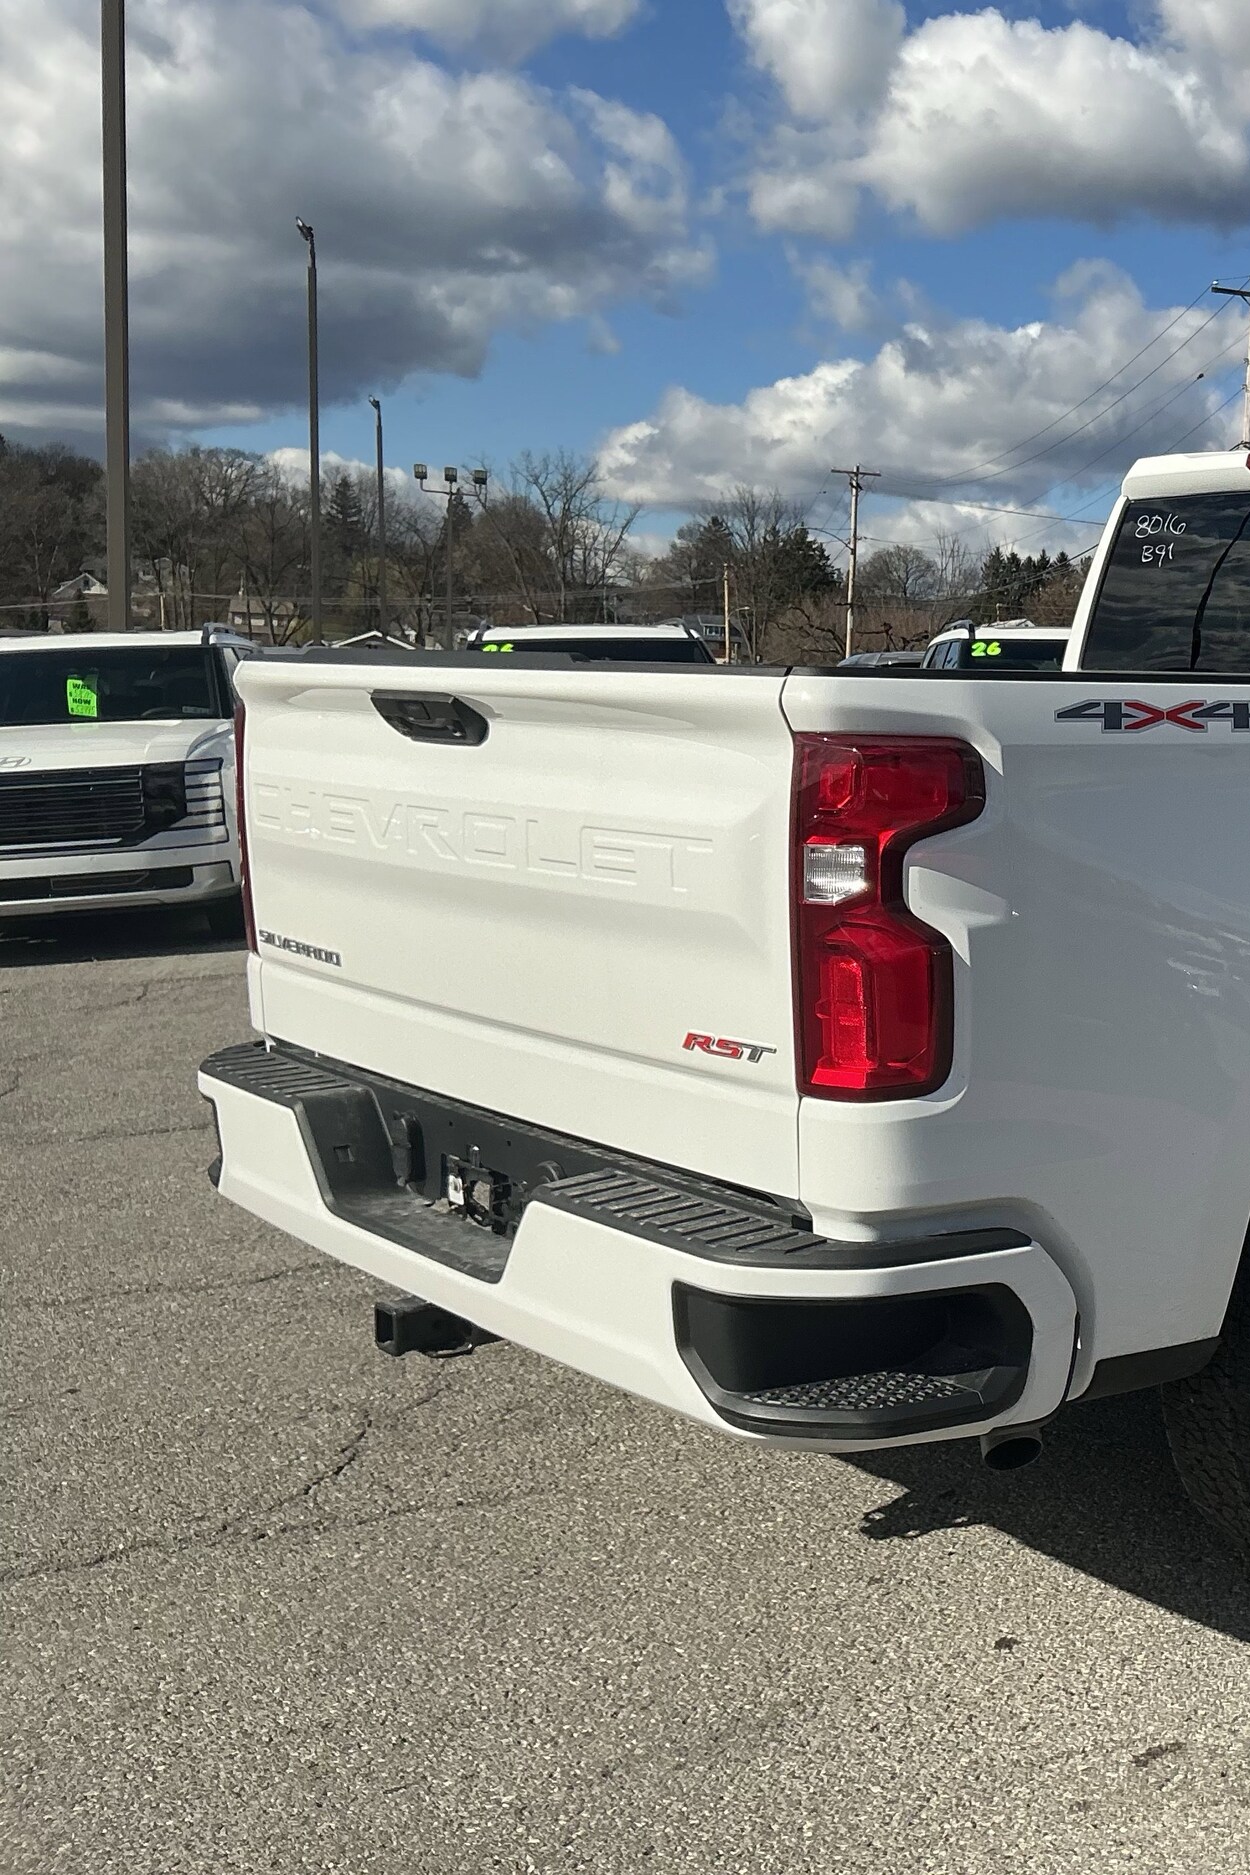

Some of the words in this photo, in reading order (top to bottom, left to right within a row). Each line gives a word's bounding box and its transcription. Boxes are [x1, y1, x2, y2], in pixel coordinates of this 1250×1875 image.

[1135, 513, 1187, 538] 8016
[1142, 542, 1174, 568] B91
[971, 641, 1002, 657] 26
[254, 782, 714, 893] CHEVROLET
[259, 929, 342, 967] SILVERADO
[682, 1032, 777, 1063] RST
